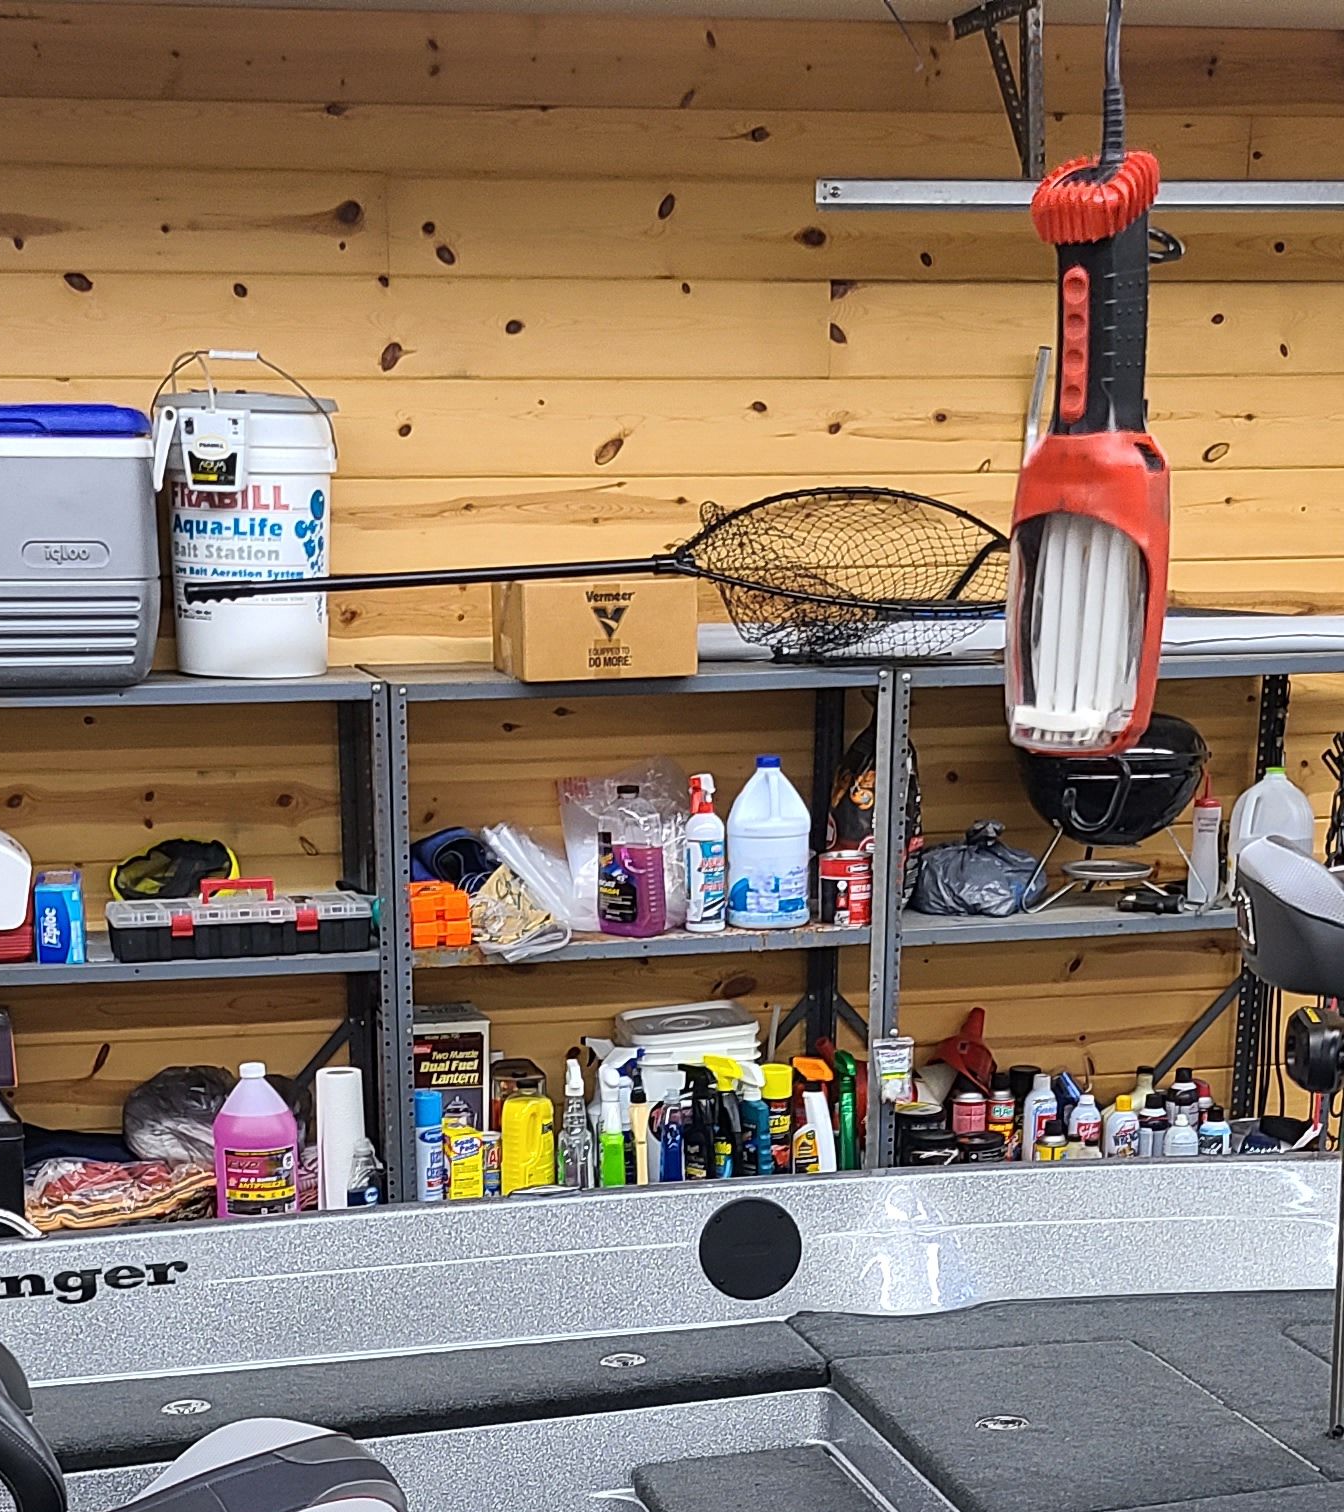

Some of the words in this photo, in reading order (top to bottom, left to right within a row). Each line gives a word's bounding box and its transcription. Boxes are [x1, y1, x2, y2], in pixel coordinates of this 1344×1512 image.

[173, 514, 283, 540] Aqua-Life
[174, 540, 199, 558] Bait
[205, 543, 281, 561] Station
[211, 567, 263, 579] Aeration
[267, 569, 305, 581] System
[586, 590, 635, 603] Vermeer
[588, 656, 602, 668] DO
[41, 907, 61, 948] Ziploc
[432, 1051, 449, 1060] Two
[450, 1049, 479, 1060] Mantle
[419, 1060, 451, 1073] Dual
[451, 1059, 479, 1071] Fuel
[431, 1073, 480, 1085] Lantern
